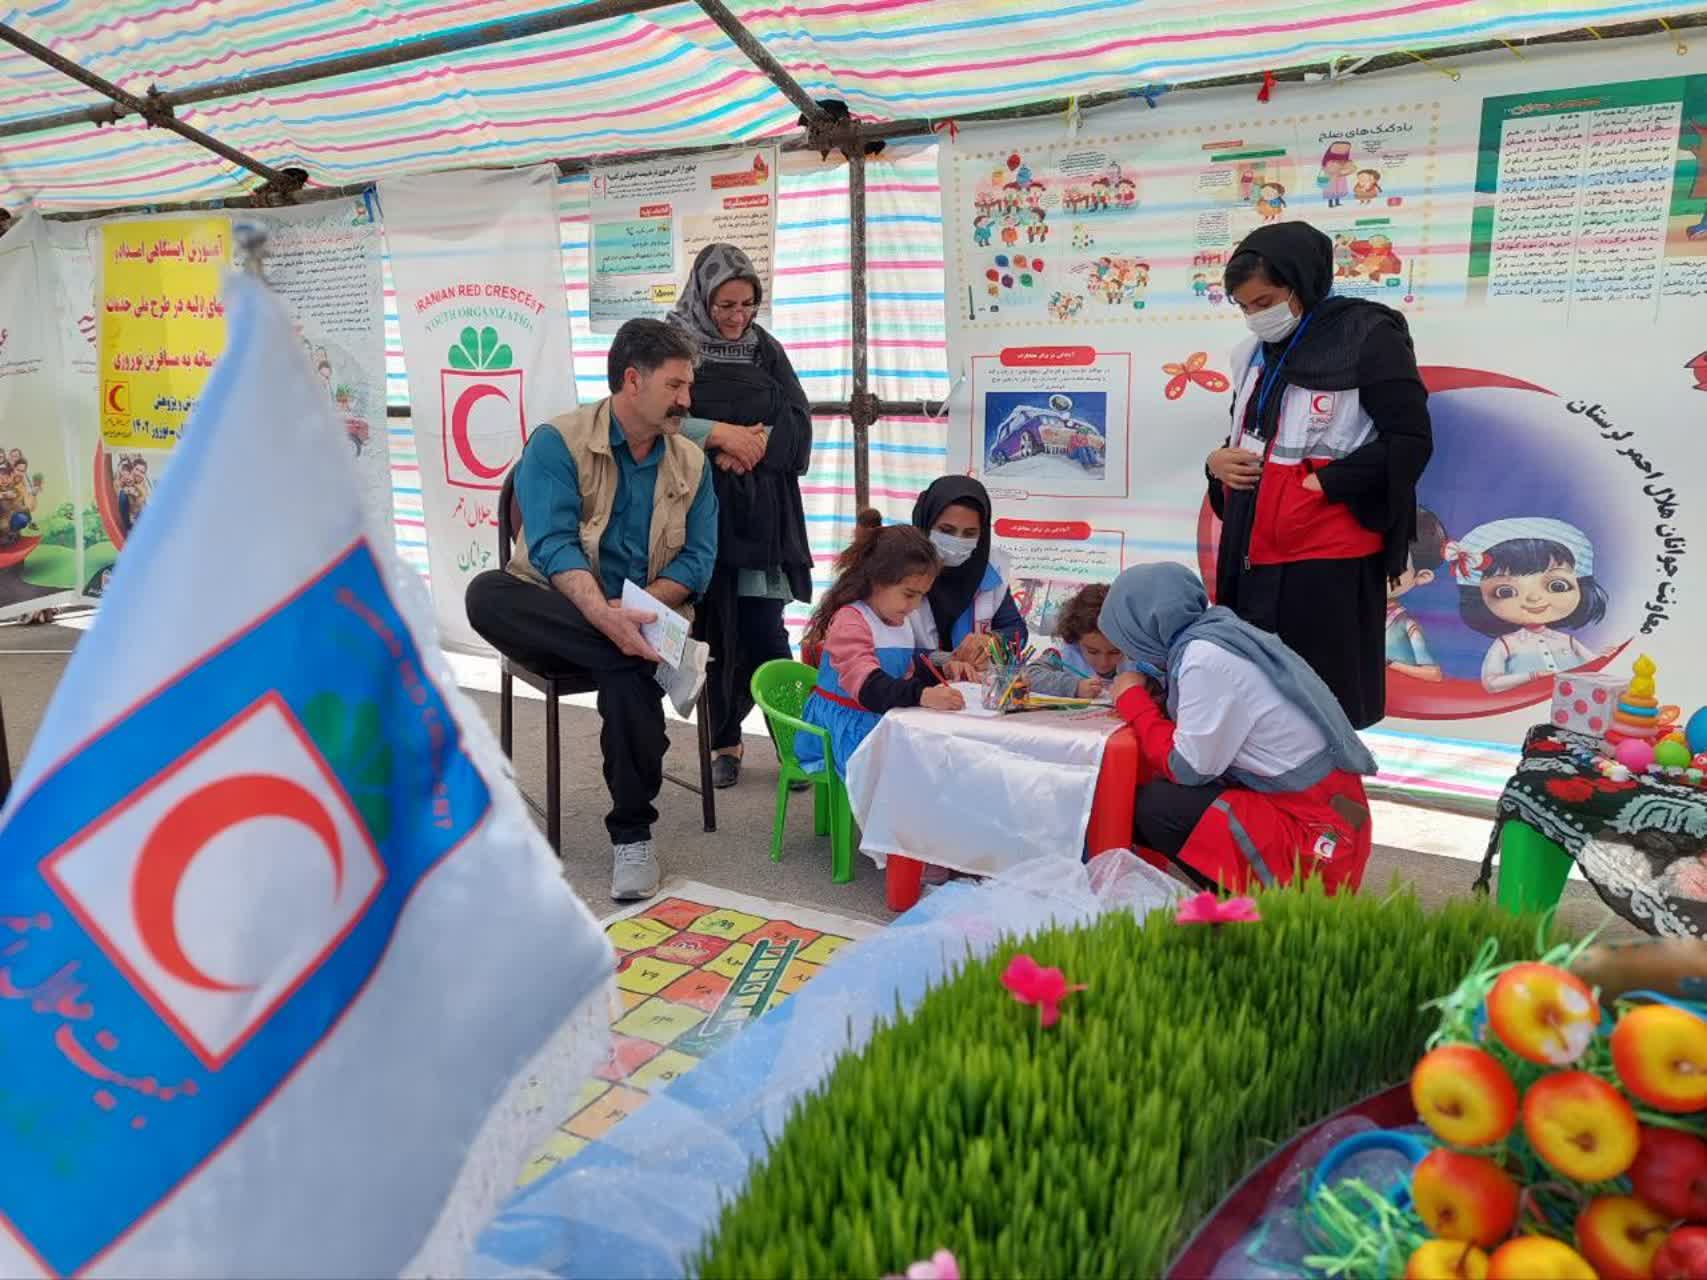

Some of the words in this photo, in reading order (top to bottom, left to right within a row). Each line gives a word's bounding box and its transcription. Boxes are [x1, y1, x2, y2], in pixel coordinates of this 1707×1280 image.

[458, 283, 481, 297] RED
[1565, 400, 1635, 441] لرستان
[1616, 448, 1664, 480] احمر
[1642, 484, 1680, 519] هلال
[1656, 524, 1686, 577] جوانان
[1640, 581, 1677, 634] معاونت
